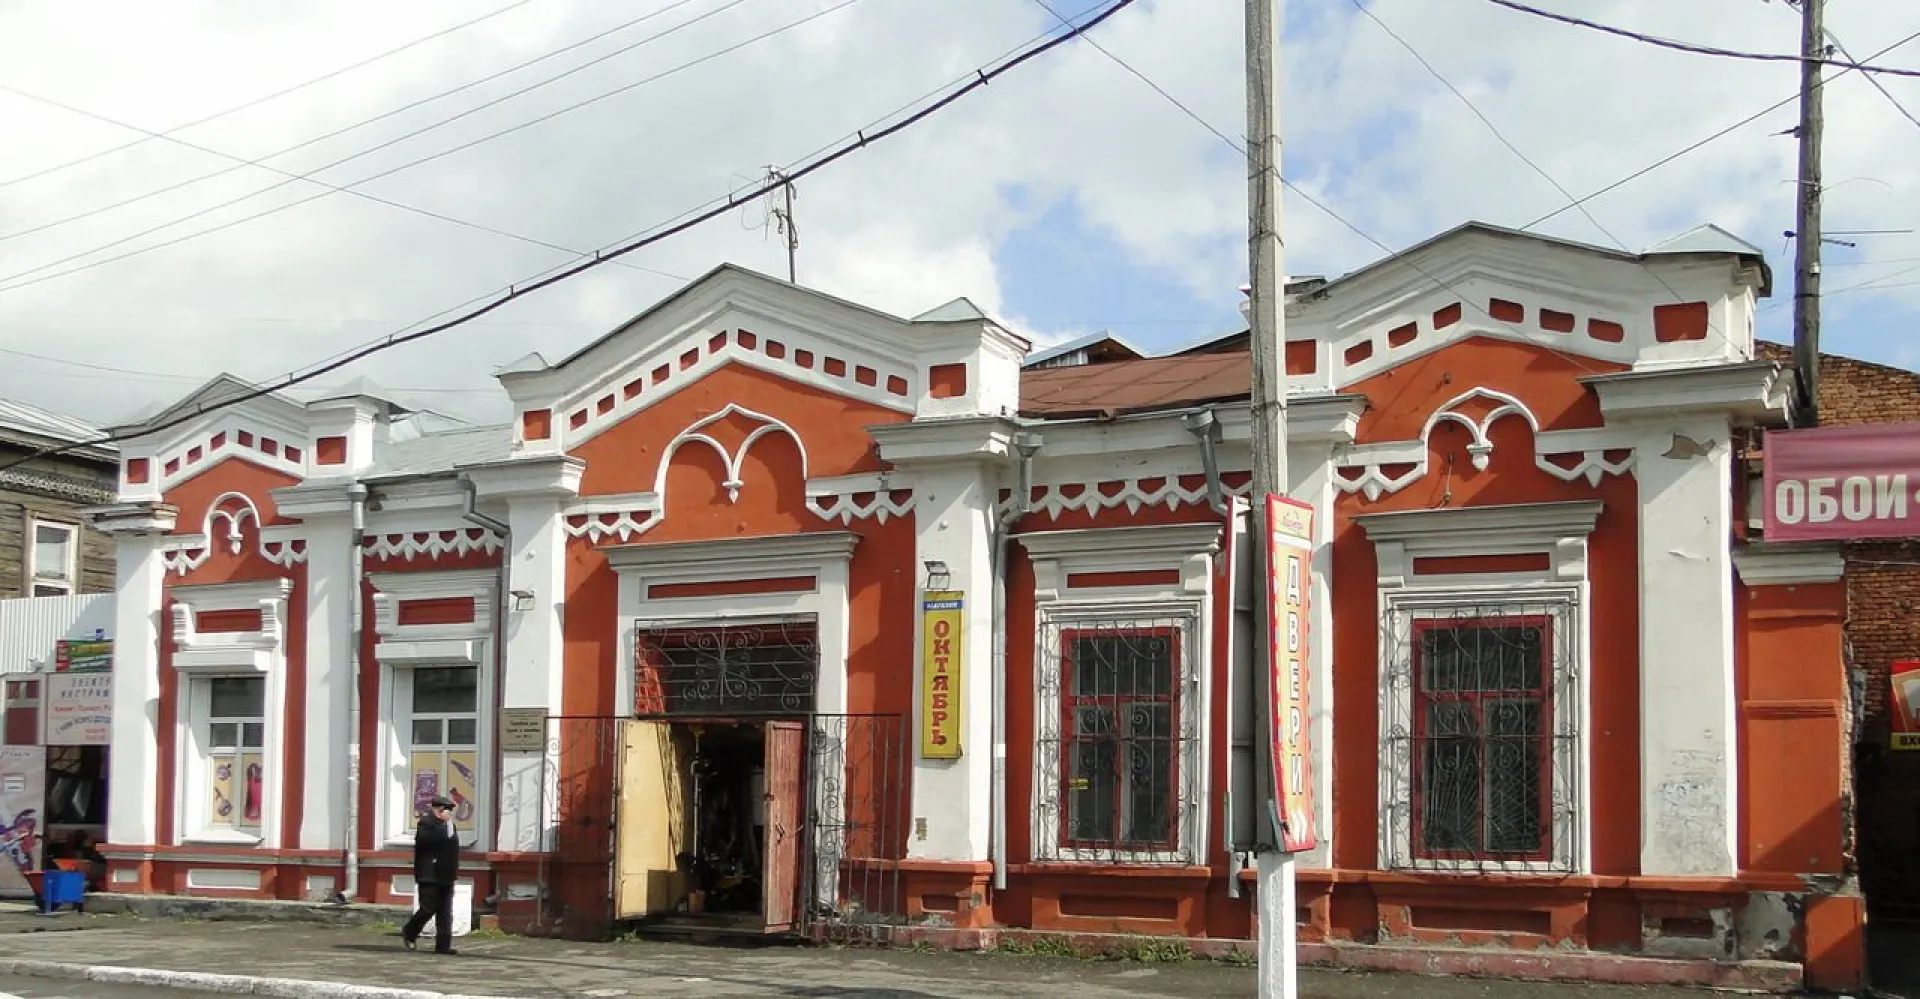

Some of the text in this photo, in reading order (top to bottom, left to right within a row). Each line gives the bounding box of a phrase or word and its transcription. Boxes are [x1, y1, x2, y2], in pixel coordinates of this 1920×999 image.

[1775, 473, 1908, 525] ОБОИ
[932, 620, 951, 745] ОКТЯБРЬ
[1287, 554, 1303, 796] ДВЕРИ
